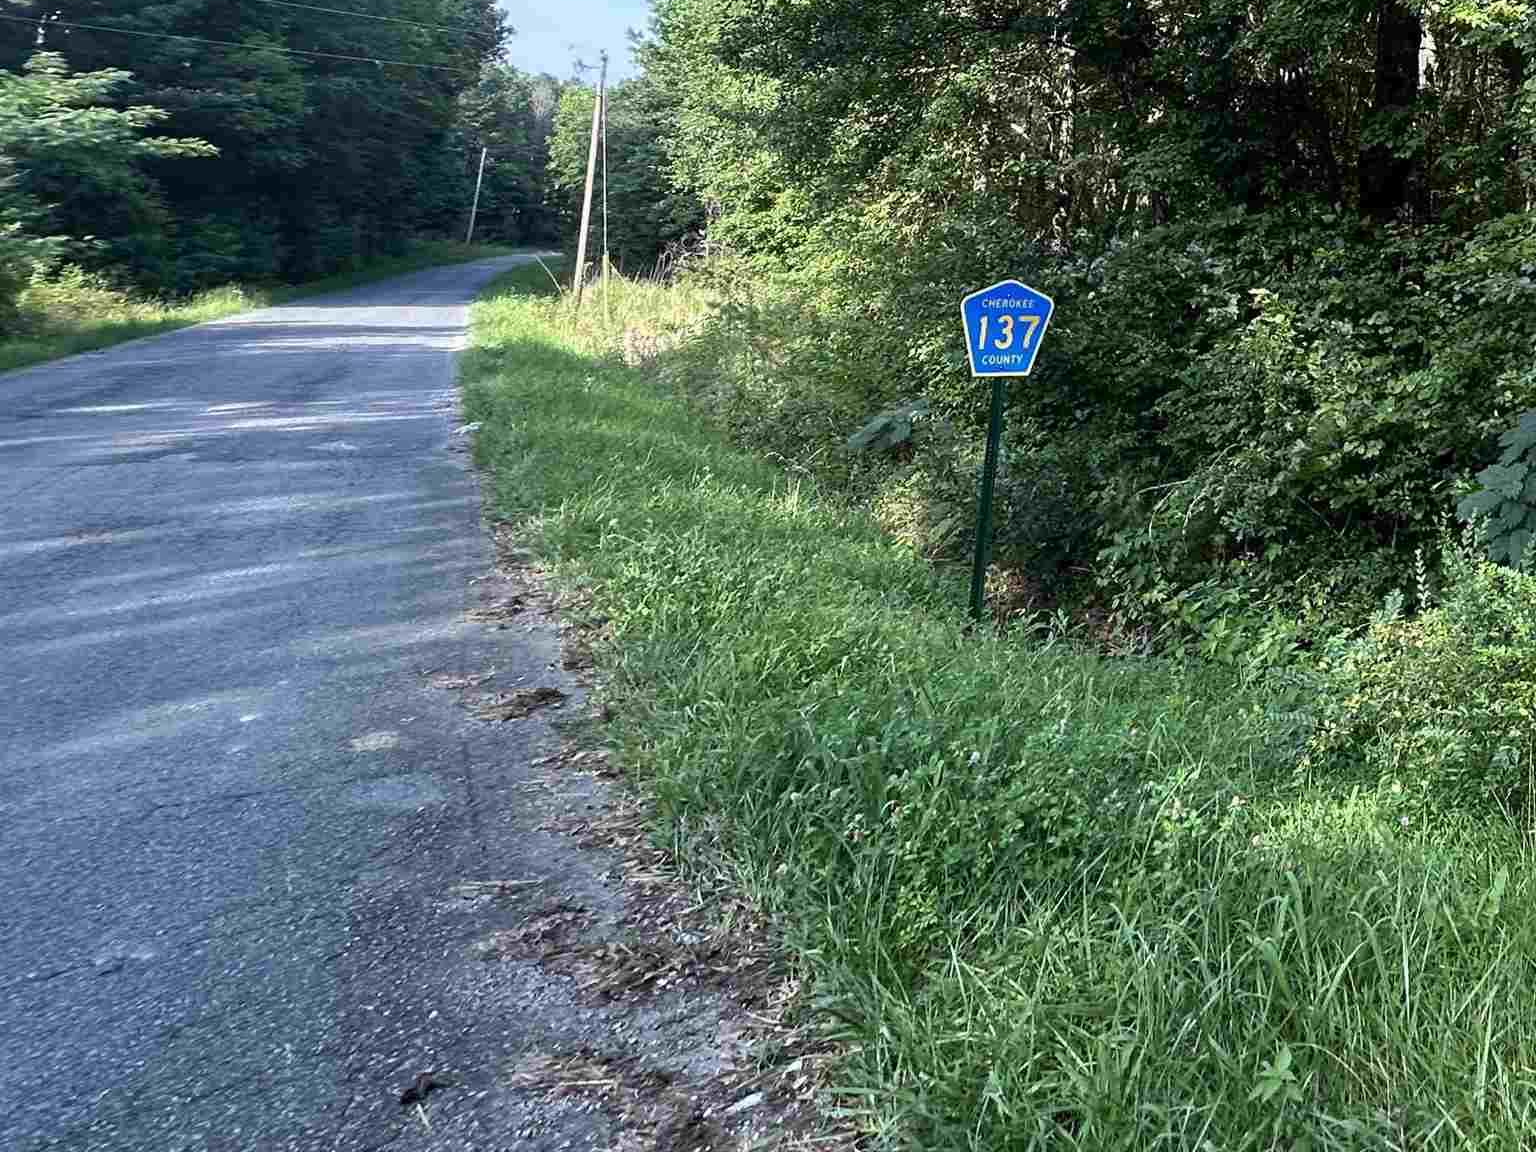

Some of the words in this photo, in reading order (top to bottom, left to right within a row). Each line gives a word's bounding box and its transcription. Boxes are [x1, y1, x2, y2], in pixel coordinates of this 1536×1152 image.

[981, 298, 1034, 309] CHEROKEE
[978, 314, 1041, 350] 137
[981, 354, 1024, 365] COUNTY
